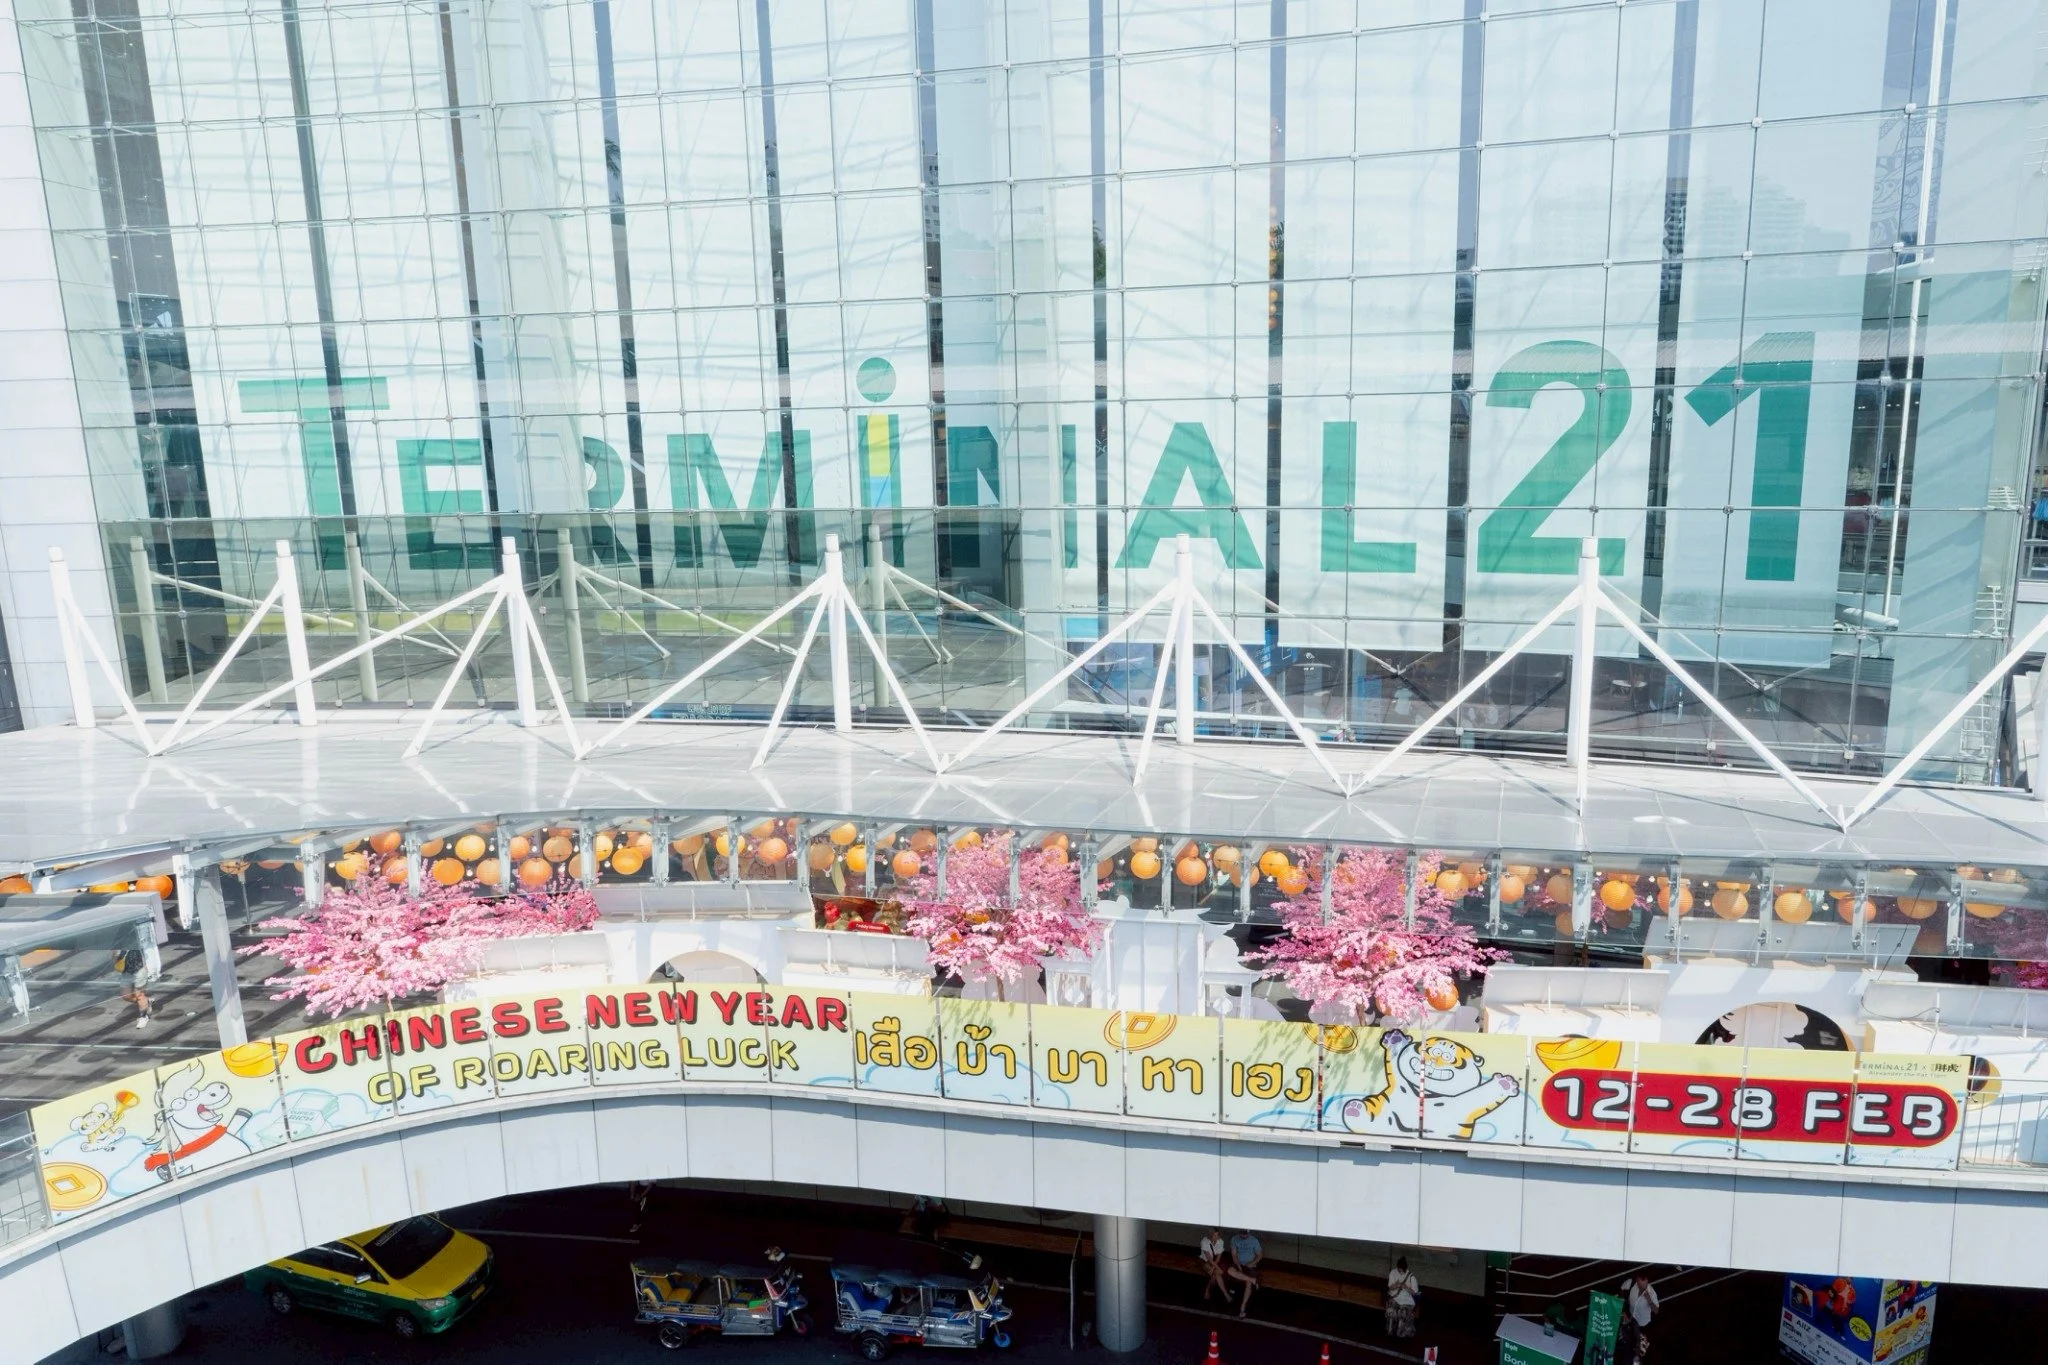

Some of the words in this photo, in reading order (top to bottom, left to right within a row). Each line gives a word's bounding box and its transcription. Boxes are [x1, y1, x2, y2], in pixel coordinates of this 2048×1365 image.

[295, 997, 571, 1074] CHINESE
[585, 990, 698, 1029] NEW
[710, 991, 849, 1033] YEAR
[367, 1064, 440, 1104] OF
[453, 1038, 670, 1090] ROARING
[681, 1036, 800, 1072] LUCK
[855, 1016, 938, 1070] เสือ
[1142, 1056, 1204, 1094] หา
[1231, 1062, 1314, 1103] เฮง
[1803, 1090, 1949, 1139] FEB
